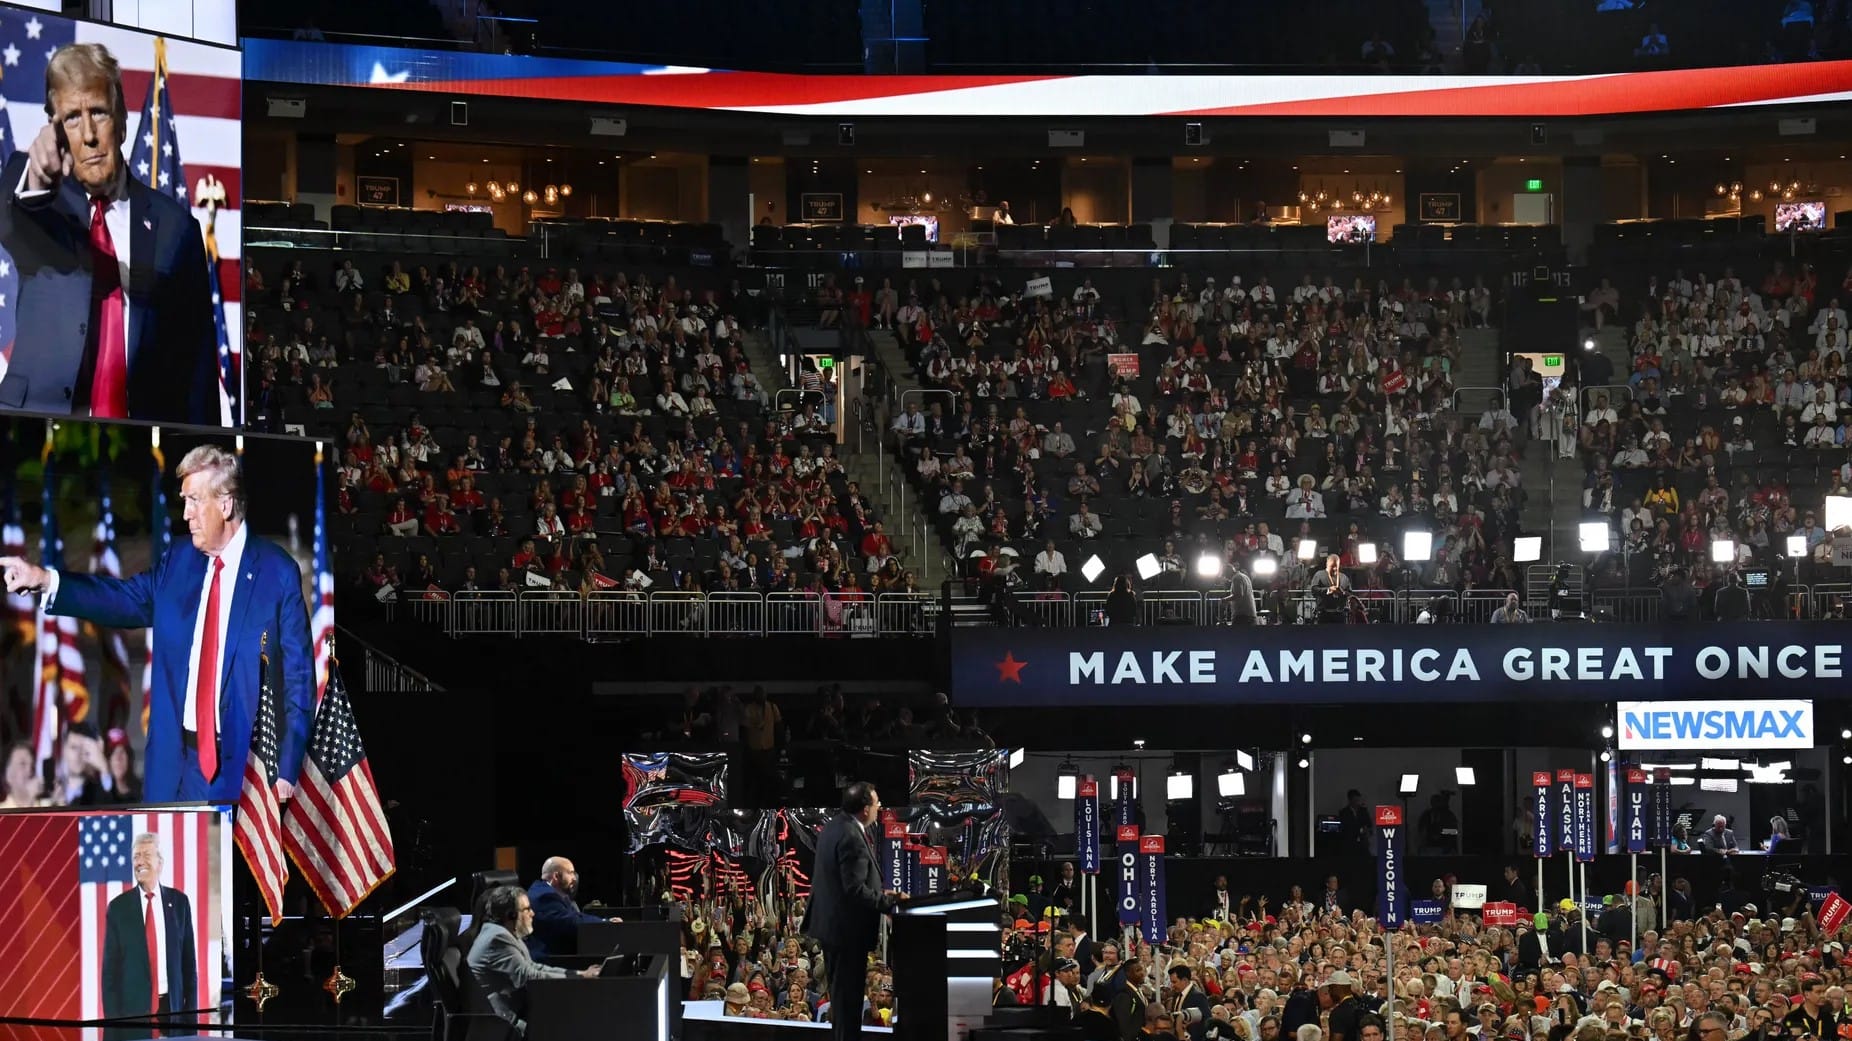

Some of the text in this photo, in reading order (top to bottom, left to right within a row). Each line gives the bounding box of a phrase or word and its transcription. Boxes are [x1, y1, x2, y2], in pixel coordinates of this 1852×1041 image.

[365, 184, 391, 192] TRUMP
[373, 191, 384, 200] 47
[808, 200, 835, 208] TRUMP
[817, 207, 828, 215] 47
[1383, 374, 1402, 387] TRUMP
[1069, 644, 1842, 684] MAKE AMERICA GREAT ONCE
[1625, 710, 1806, 739] NEWSMAX
[1538, 787, 1546, 853] MARYLAND
[1562, 784, 1572, 844] ALASKA
[1577, 793, 1585, 853] NORTHERN
[1632, 793, 1641, 839] UTAH
[1123, 853, 1135, 910] OHIO
[1383, 828, 1396, 923] WISCONSIN
[1150, 889, 1158, 940] CAROLINA
[1413, 906, 1442, 914] TRUMP
[1485, 908, 1514, 917] TRUMP
[1821, 898, 1839, 927] TRUMP
